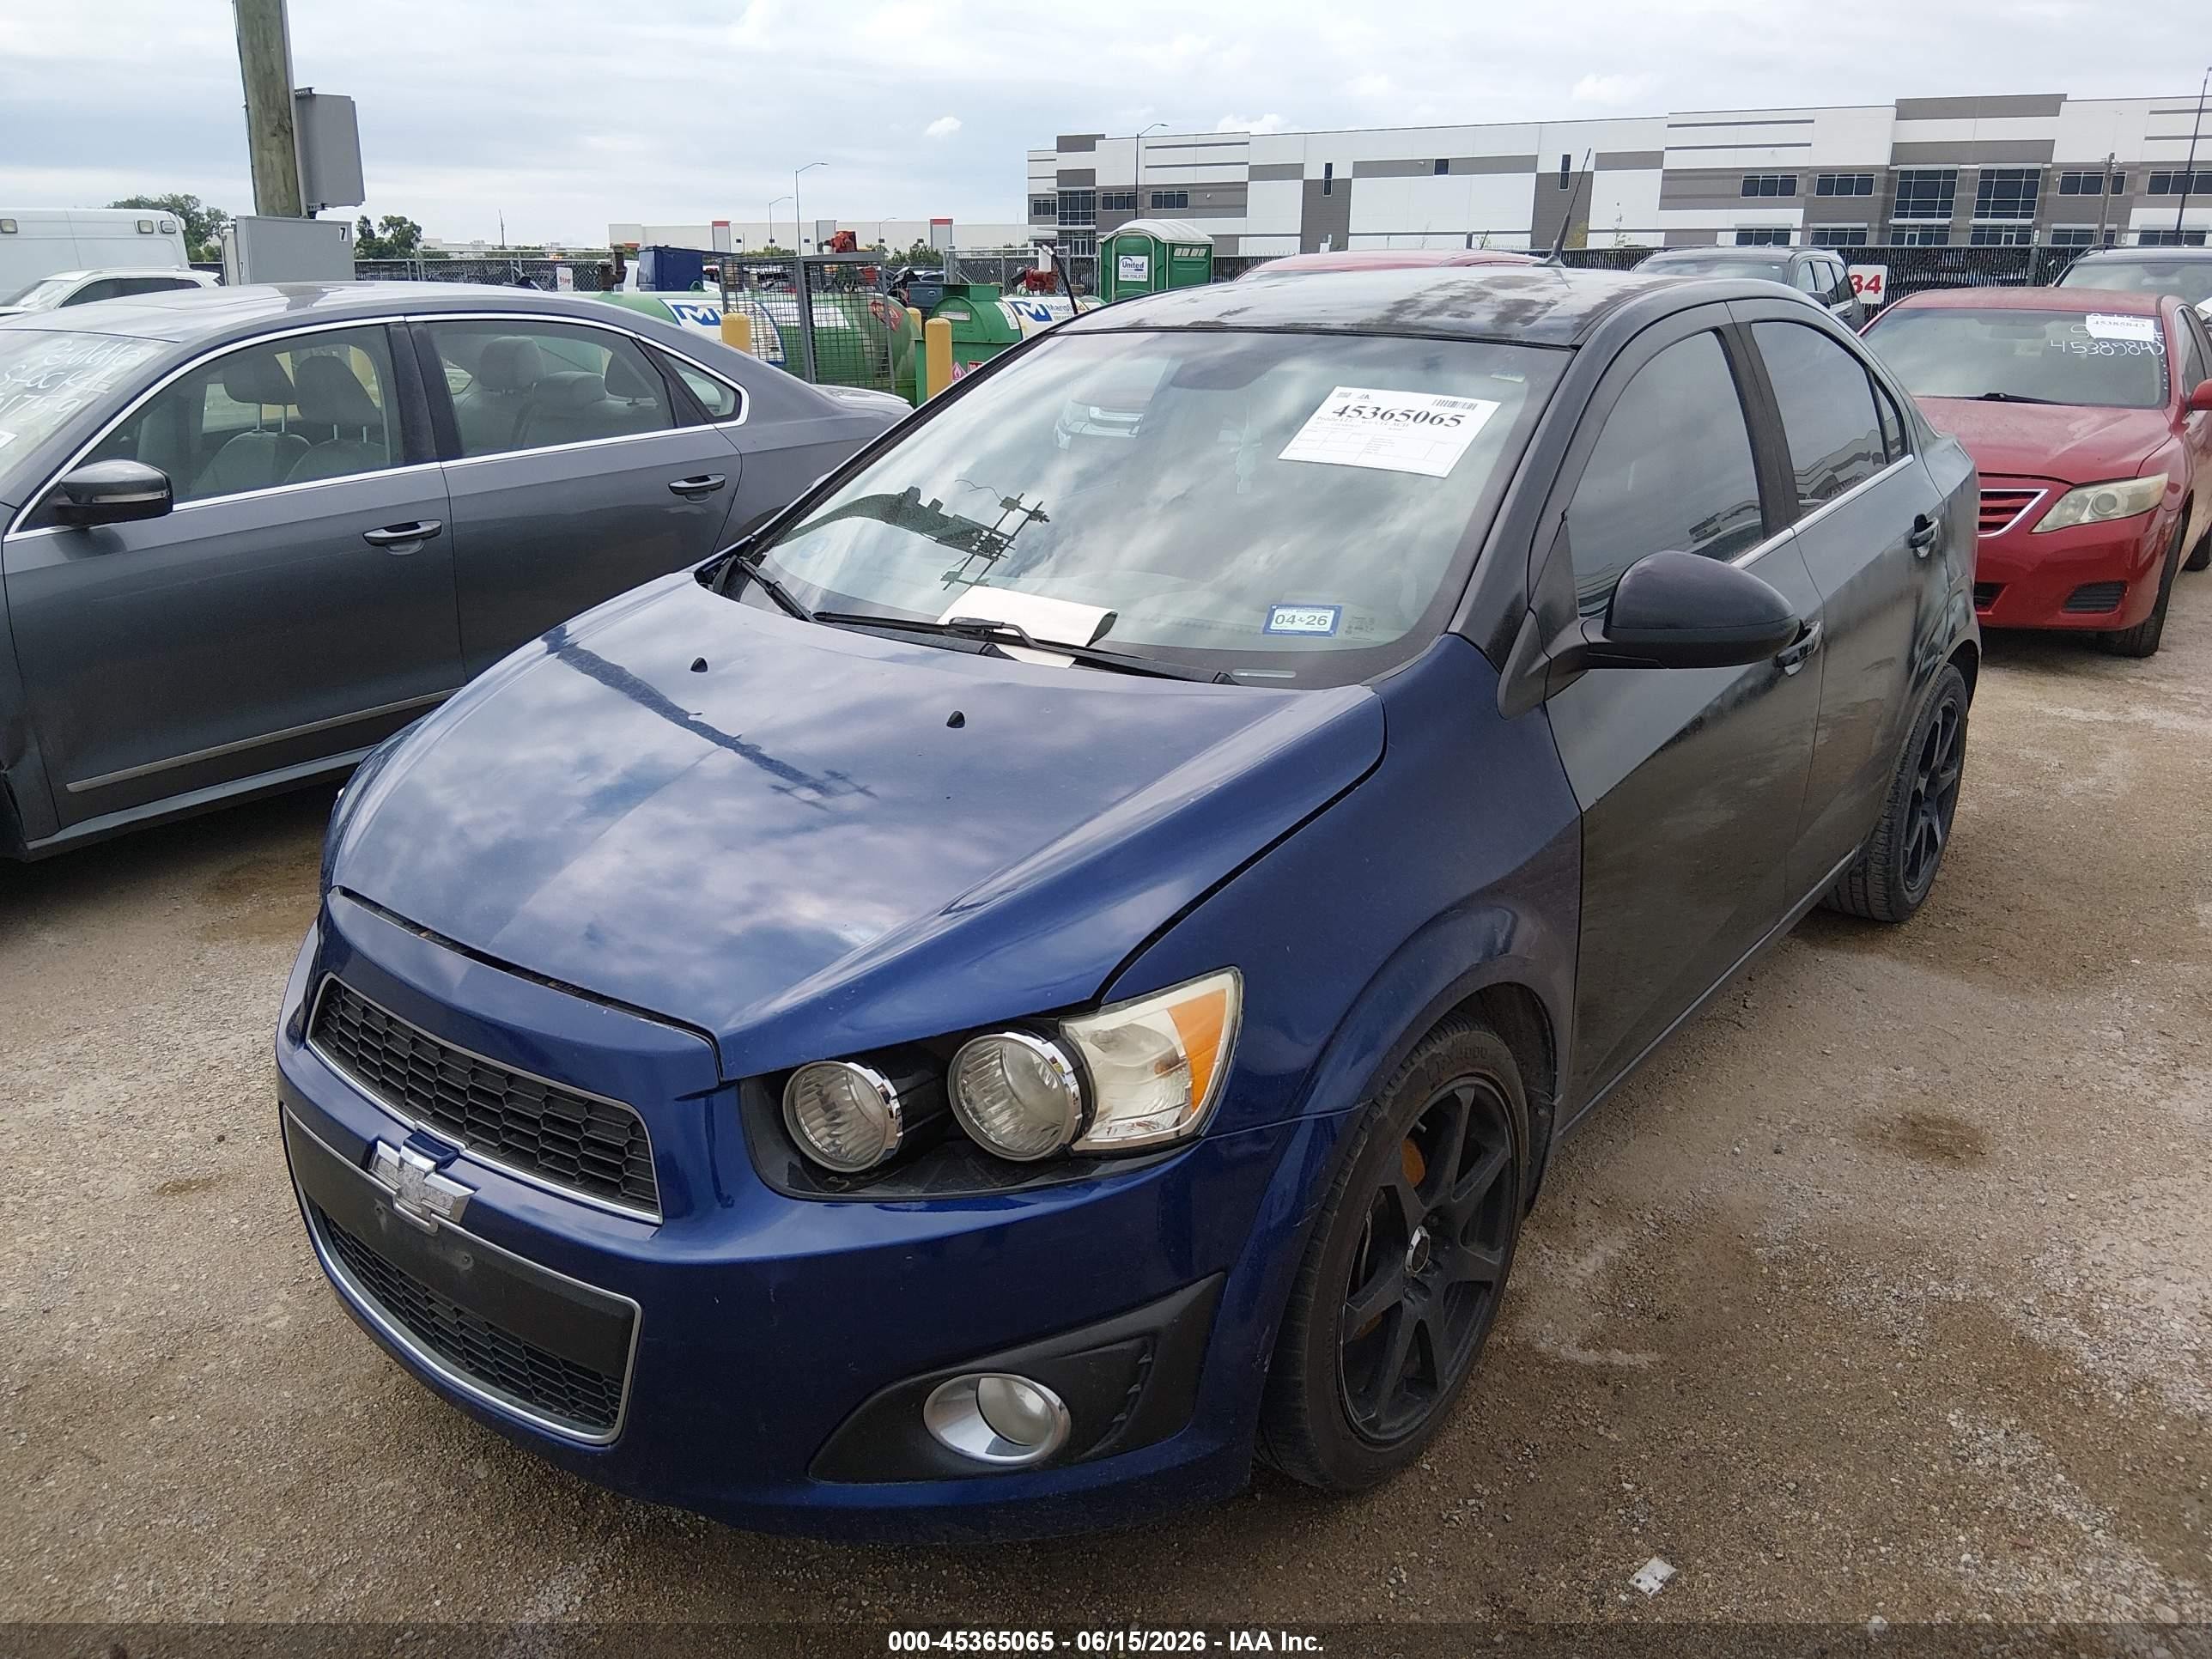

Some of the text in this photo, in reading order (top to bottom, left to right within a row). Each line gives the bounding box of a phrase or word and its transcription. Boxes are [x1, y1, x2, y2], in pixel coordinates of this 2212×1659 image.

[340, 228, 346, 240] 7
[1850, 274, 1881, 295] 34
[2050, 339, 2165, 356] 45385843
[1332, 404, 1467, 428] 45365065
